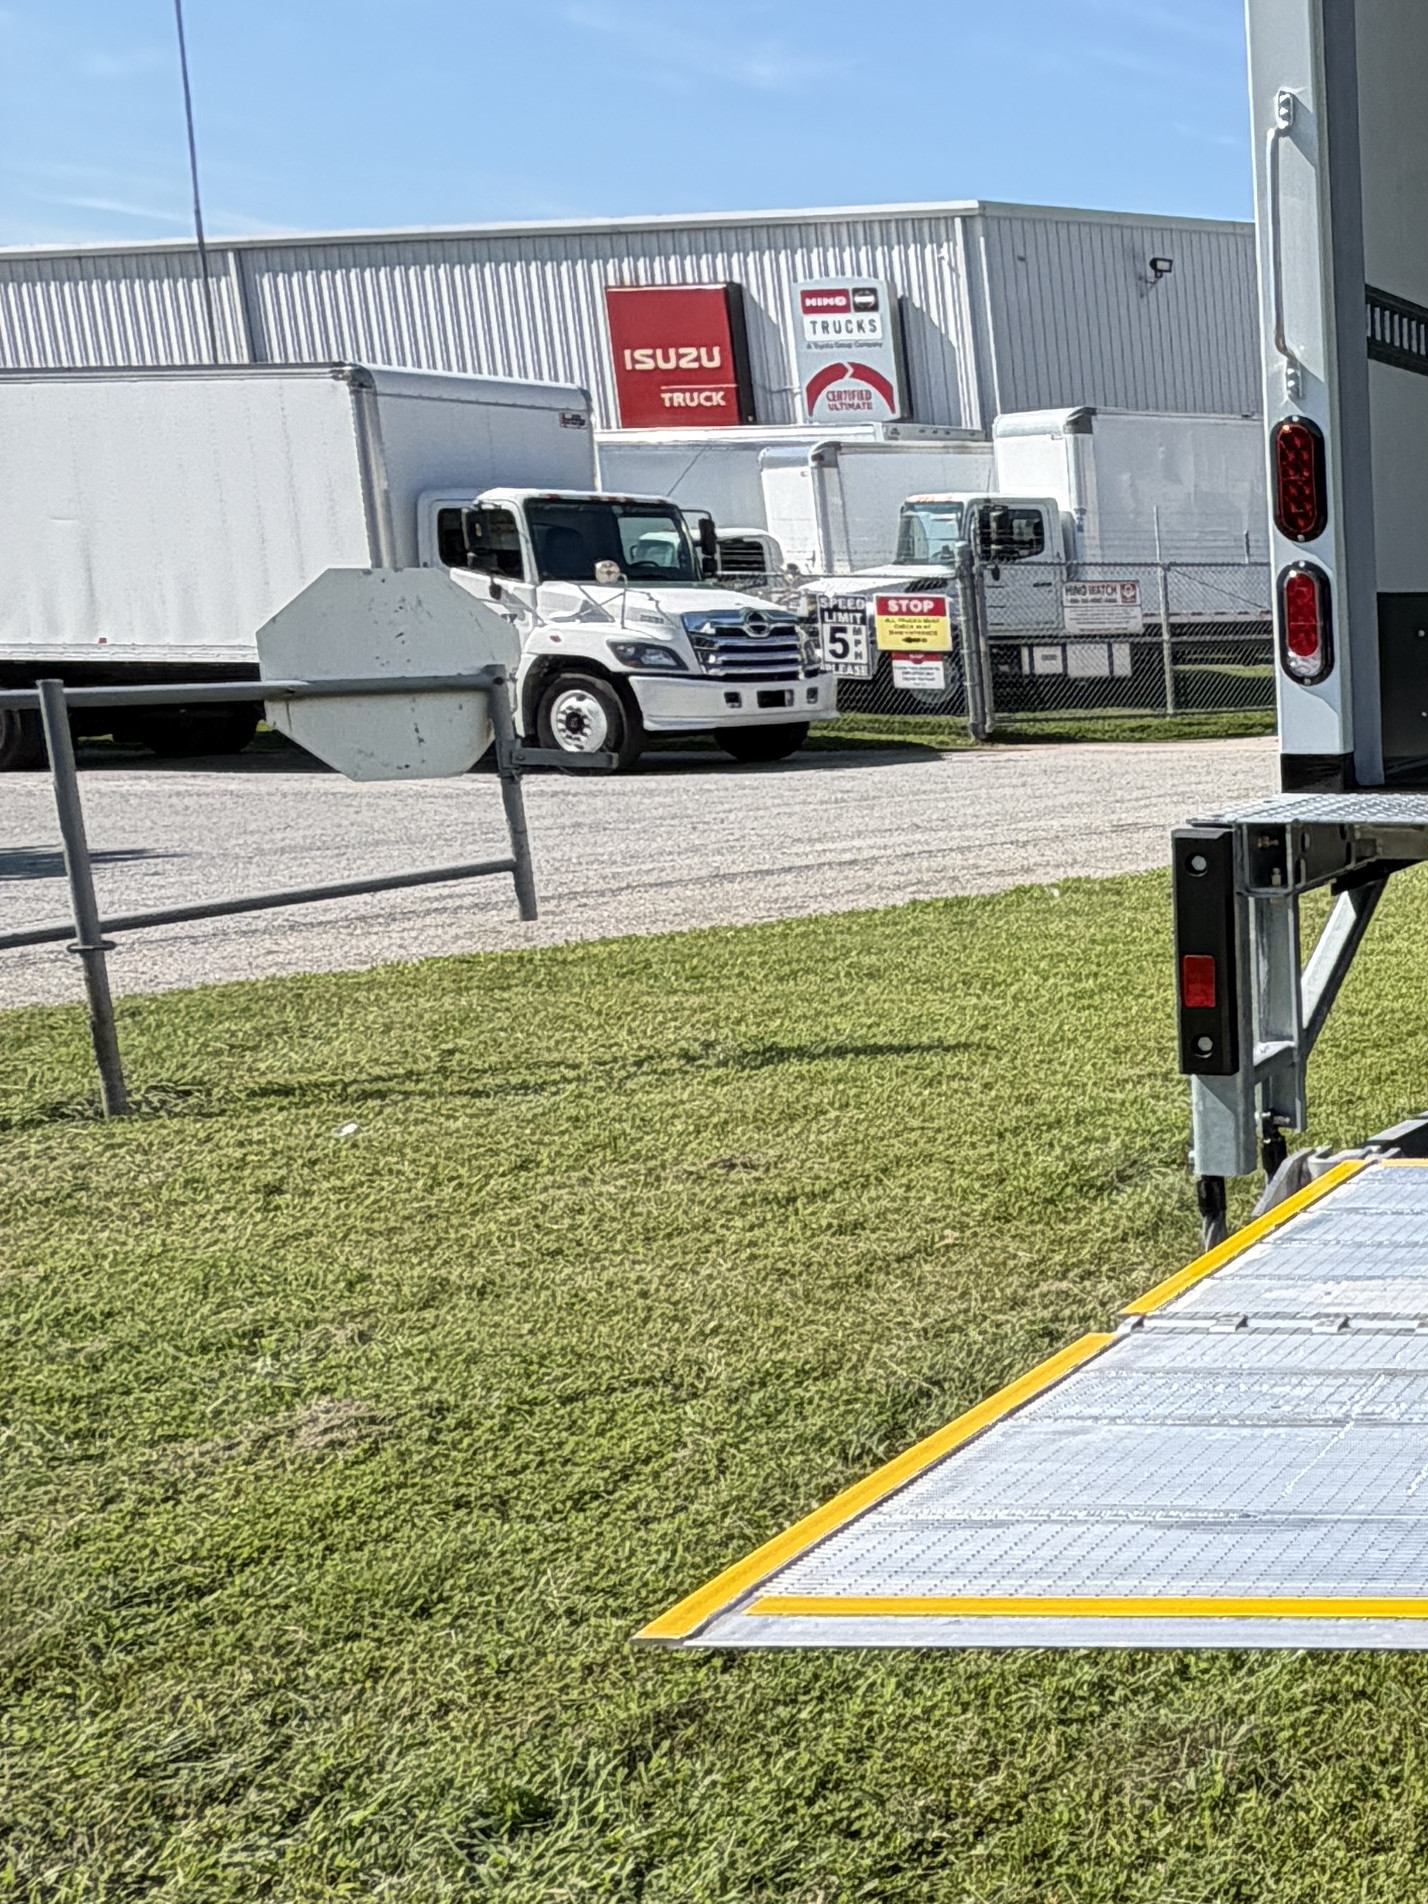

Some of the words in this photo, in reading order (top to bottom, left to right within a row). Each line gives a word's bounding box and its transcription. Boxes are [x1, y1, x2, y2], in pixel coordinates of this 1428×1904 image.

[810, 319, 877, 335] TRUCKS
[623, 346, 721, 371] ISUZU
[660, 391, 726, 408] TRUCK
[826, 389, 872, 402] CERTIFIED
[827, 401, 873, 411] ULTIMATE
[819, 597, 866, 610] SPEED
[887, 600, 935, 613] STOP
[823, 611, 863, 624] LIMIT
[828, 626, 850, 659] 5
